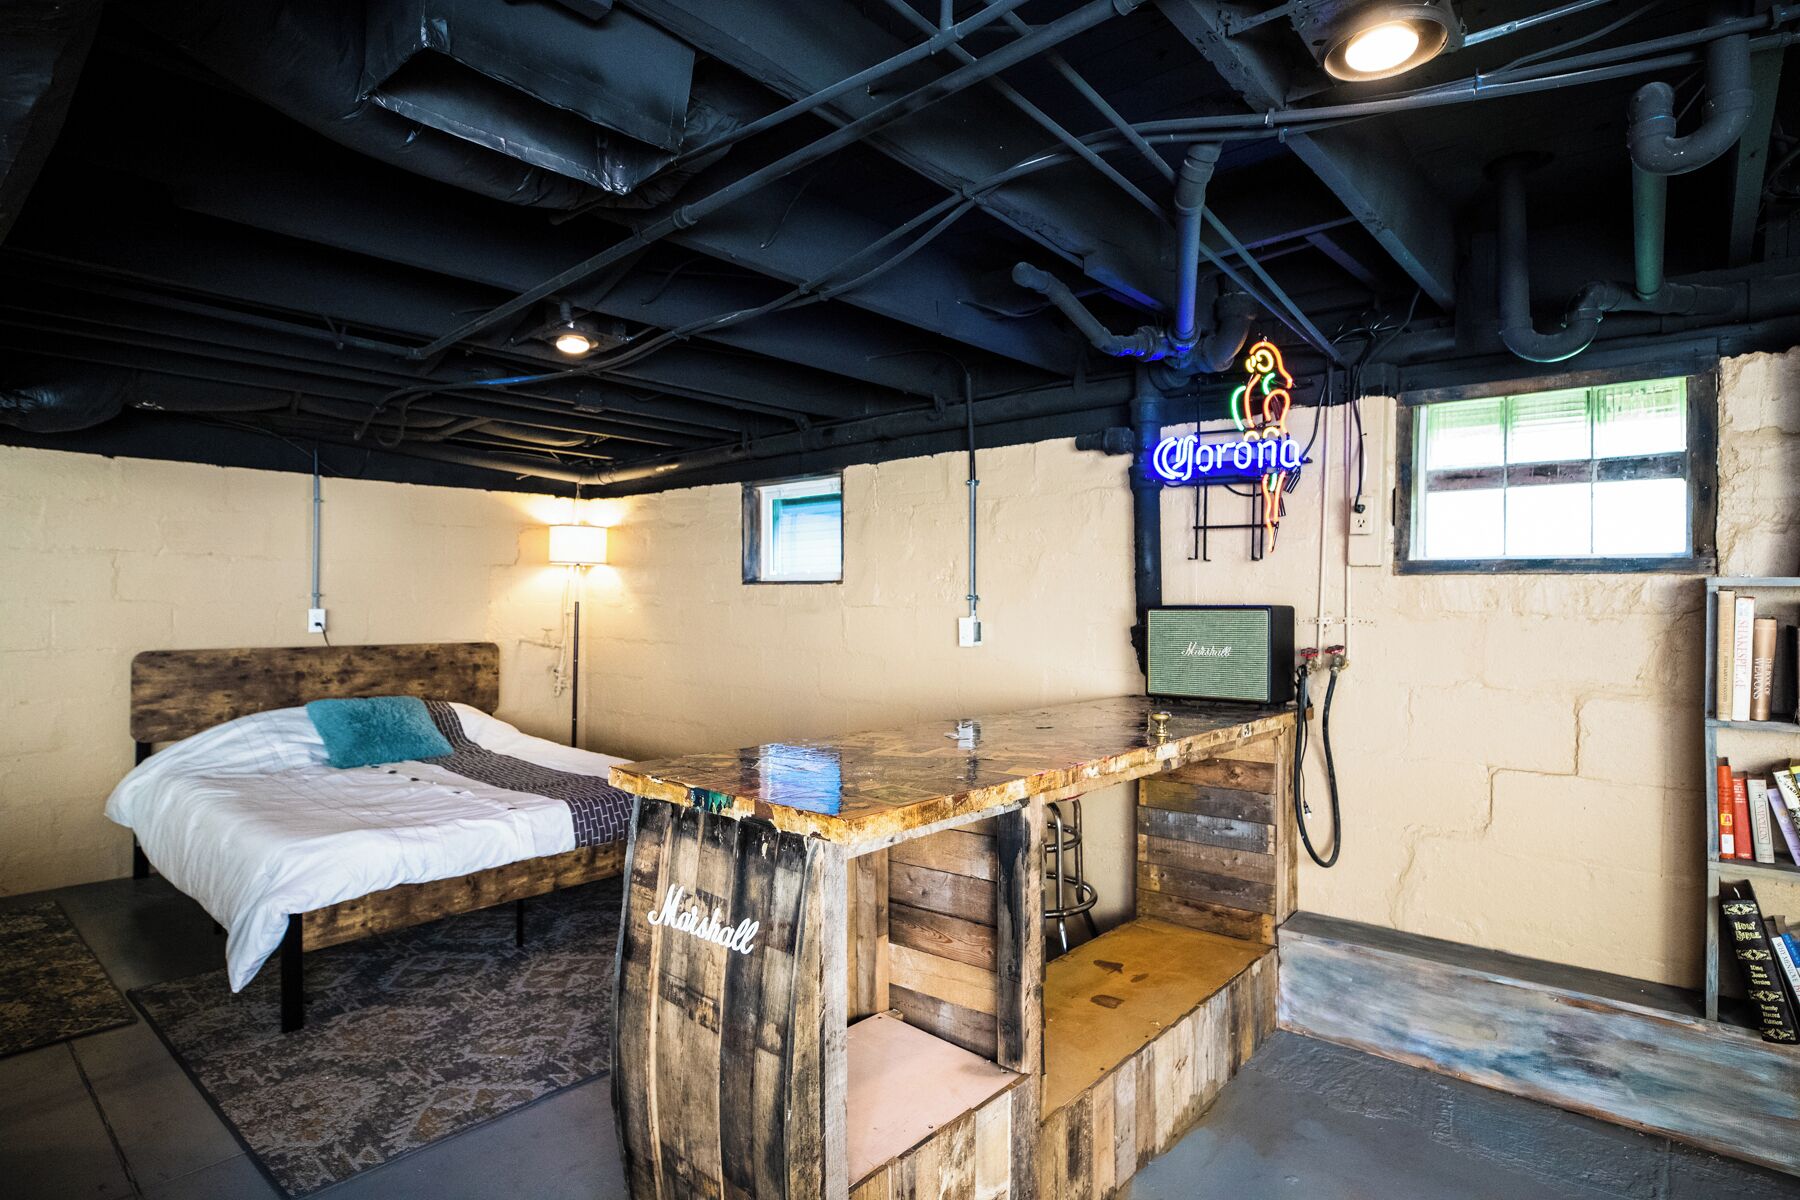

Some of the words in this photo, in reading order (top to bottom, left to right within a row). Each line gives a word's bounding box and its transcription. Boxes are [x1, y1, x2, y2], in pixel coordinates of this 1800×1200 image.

[1153, 435, 1301, 481] Corona
[1181, 641, 1232, 657] Marshall
[1735, 619, 1748, 689] SHAKESPEARE
[1753, 657, 1762, 700] WEAPONS
[647, 883, 760, 955] Marshall
